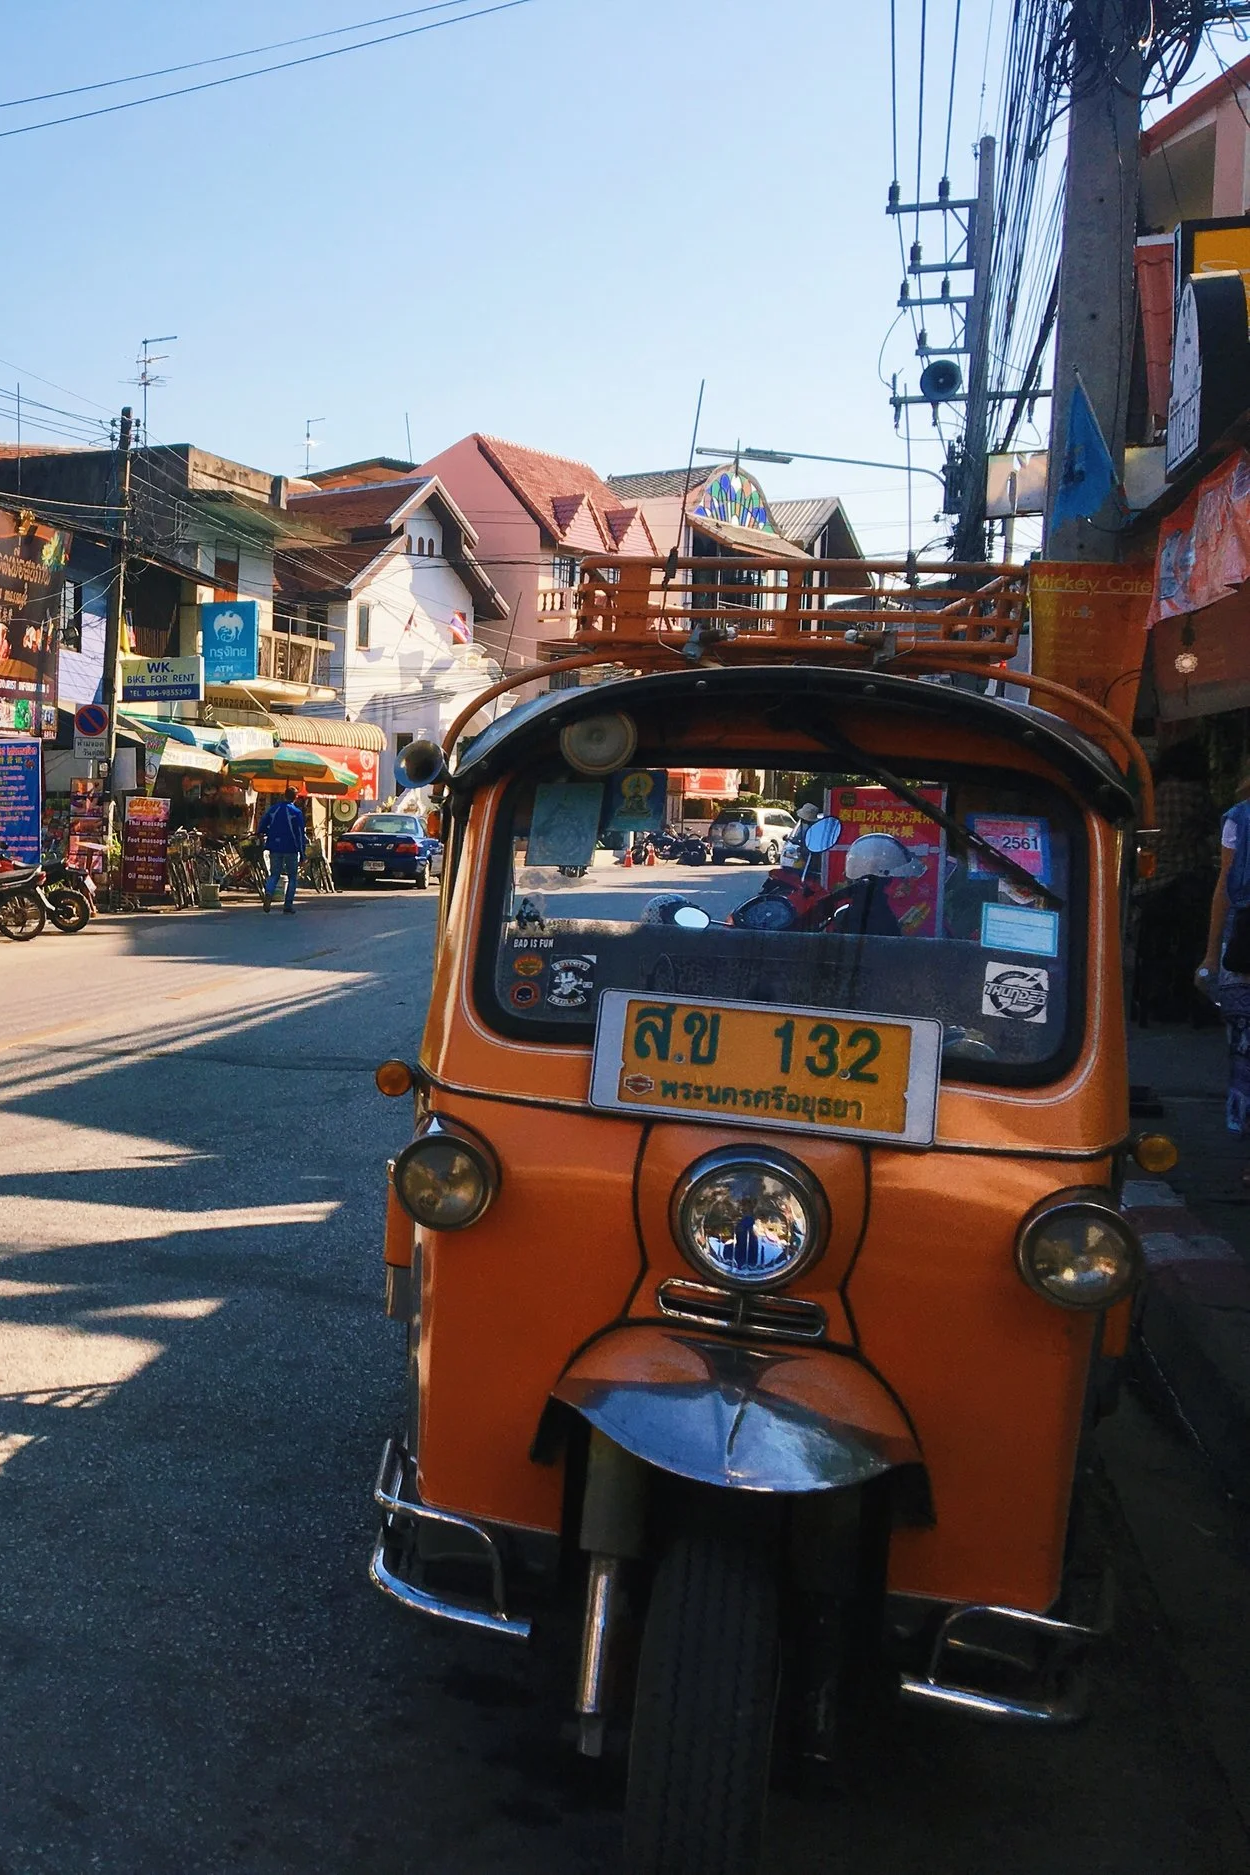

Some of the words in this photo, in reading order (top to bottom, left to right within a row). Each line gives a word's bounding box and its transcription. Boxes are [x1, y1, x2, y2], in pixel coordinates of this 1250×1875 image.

[1032, 573, 1100, 596] Mickey
[209, 645, 247, 660] กรุงไทย
[146, 662, 174, 674] WK.
[214, 665, 234, 673] ATM
[127, 675, 146, 684] BIKE
[150, 674, 168, 684] FOR
[172, 673, 196, 683] RENT
[0, 679, 17, 691] TOURIST
[6, 745, 37, 756] Information
[128, 819, 141, 828] Thai
[142, 821, 167, 829] massage
[127, 836, 140, 844] Foot
[1001, 835, 1039, 850] 2561
[127, 872, 137, 880] Oil
[137, 874, 162, 882] massage
[513, 938, 529, 948] BAD
[530, 938, 538, 948] IS
[538, 938, 555, 948] FUN
[774, 1019, 882, 1085] 132
[659, 1076, 863, 1123] พระนครศรีอยุธยา
